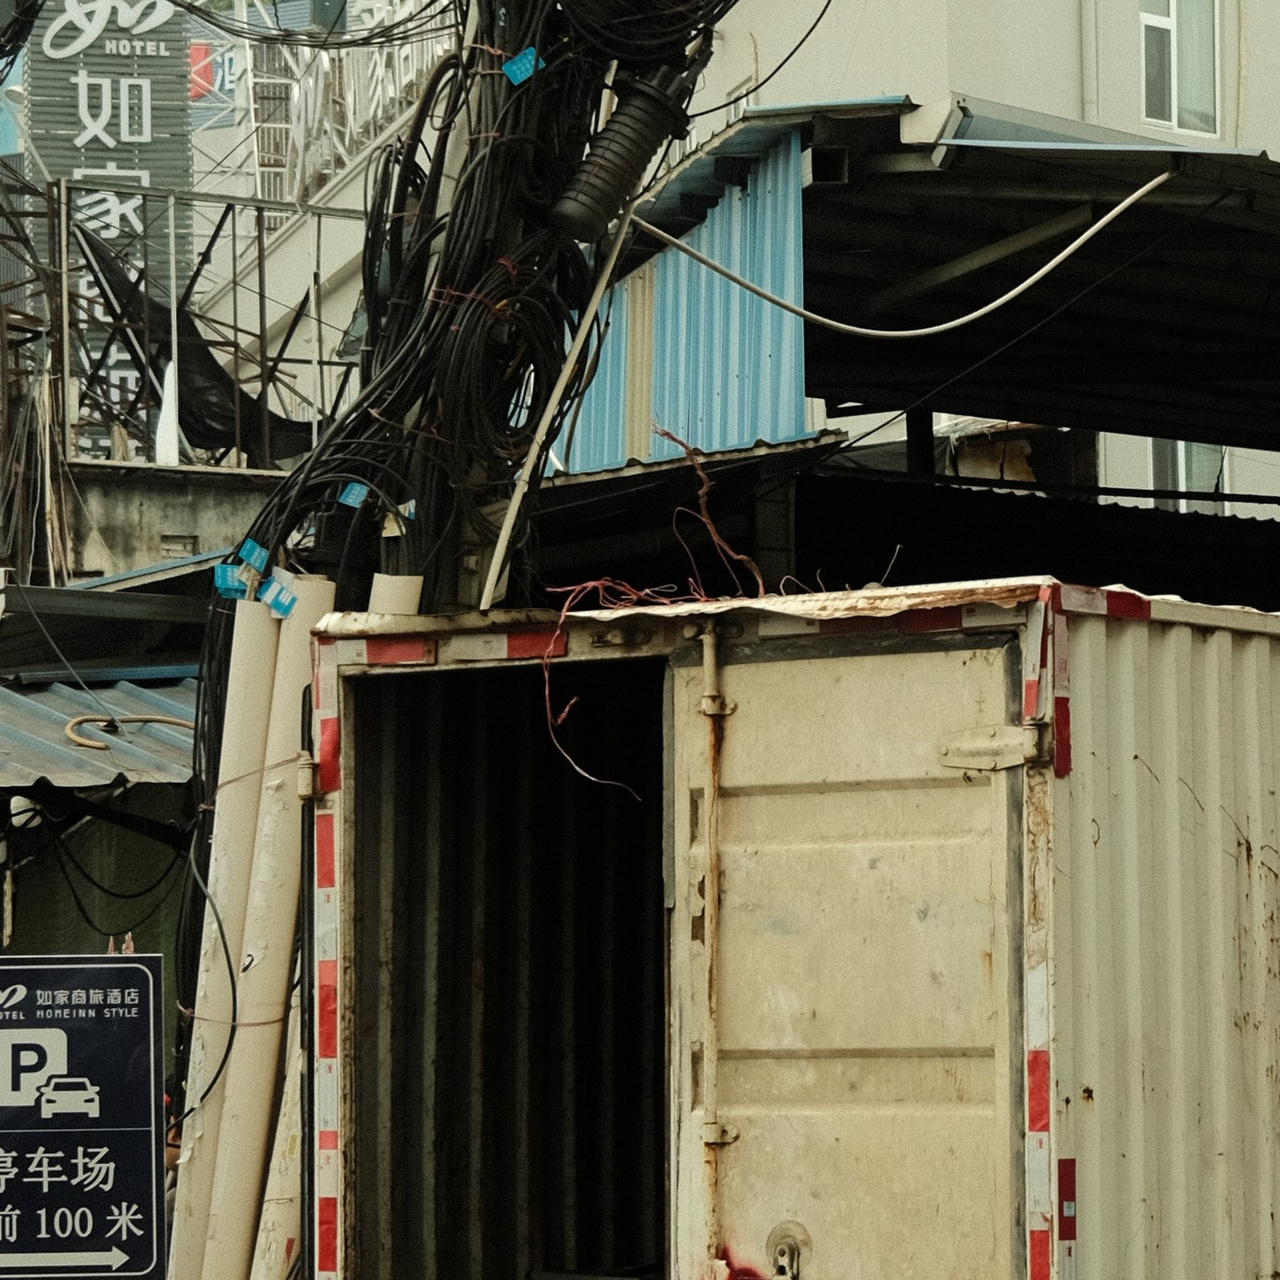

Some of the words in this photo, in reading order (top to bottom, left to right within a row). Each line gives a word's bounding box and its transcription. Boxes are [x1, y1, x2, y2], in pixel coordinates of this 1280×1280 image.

[105, 39, 170, 57] HOTEL
[36, 988, 140, 1006] 如家商旅酒店
[36, 1008, 96, 1019] HOMEINN
[103, 1007, 139, 1018] STYLE
[36, 1207, 93, 1238] 100
[105, 1201, 145, 1241] 米
